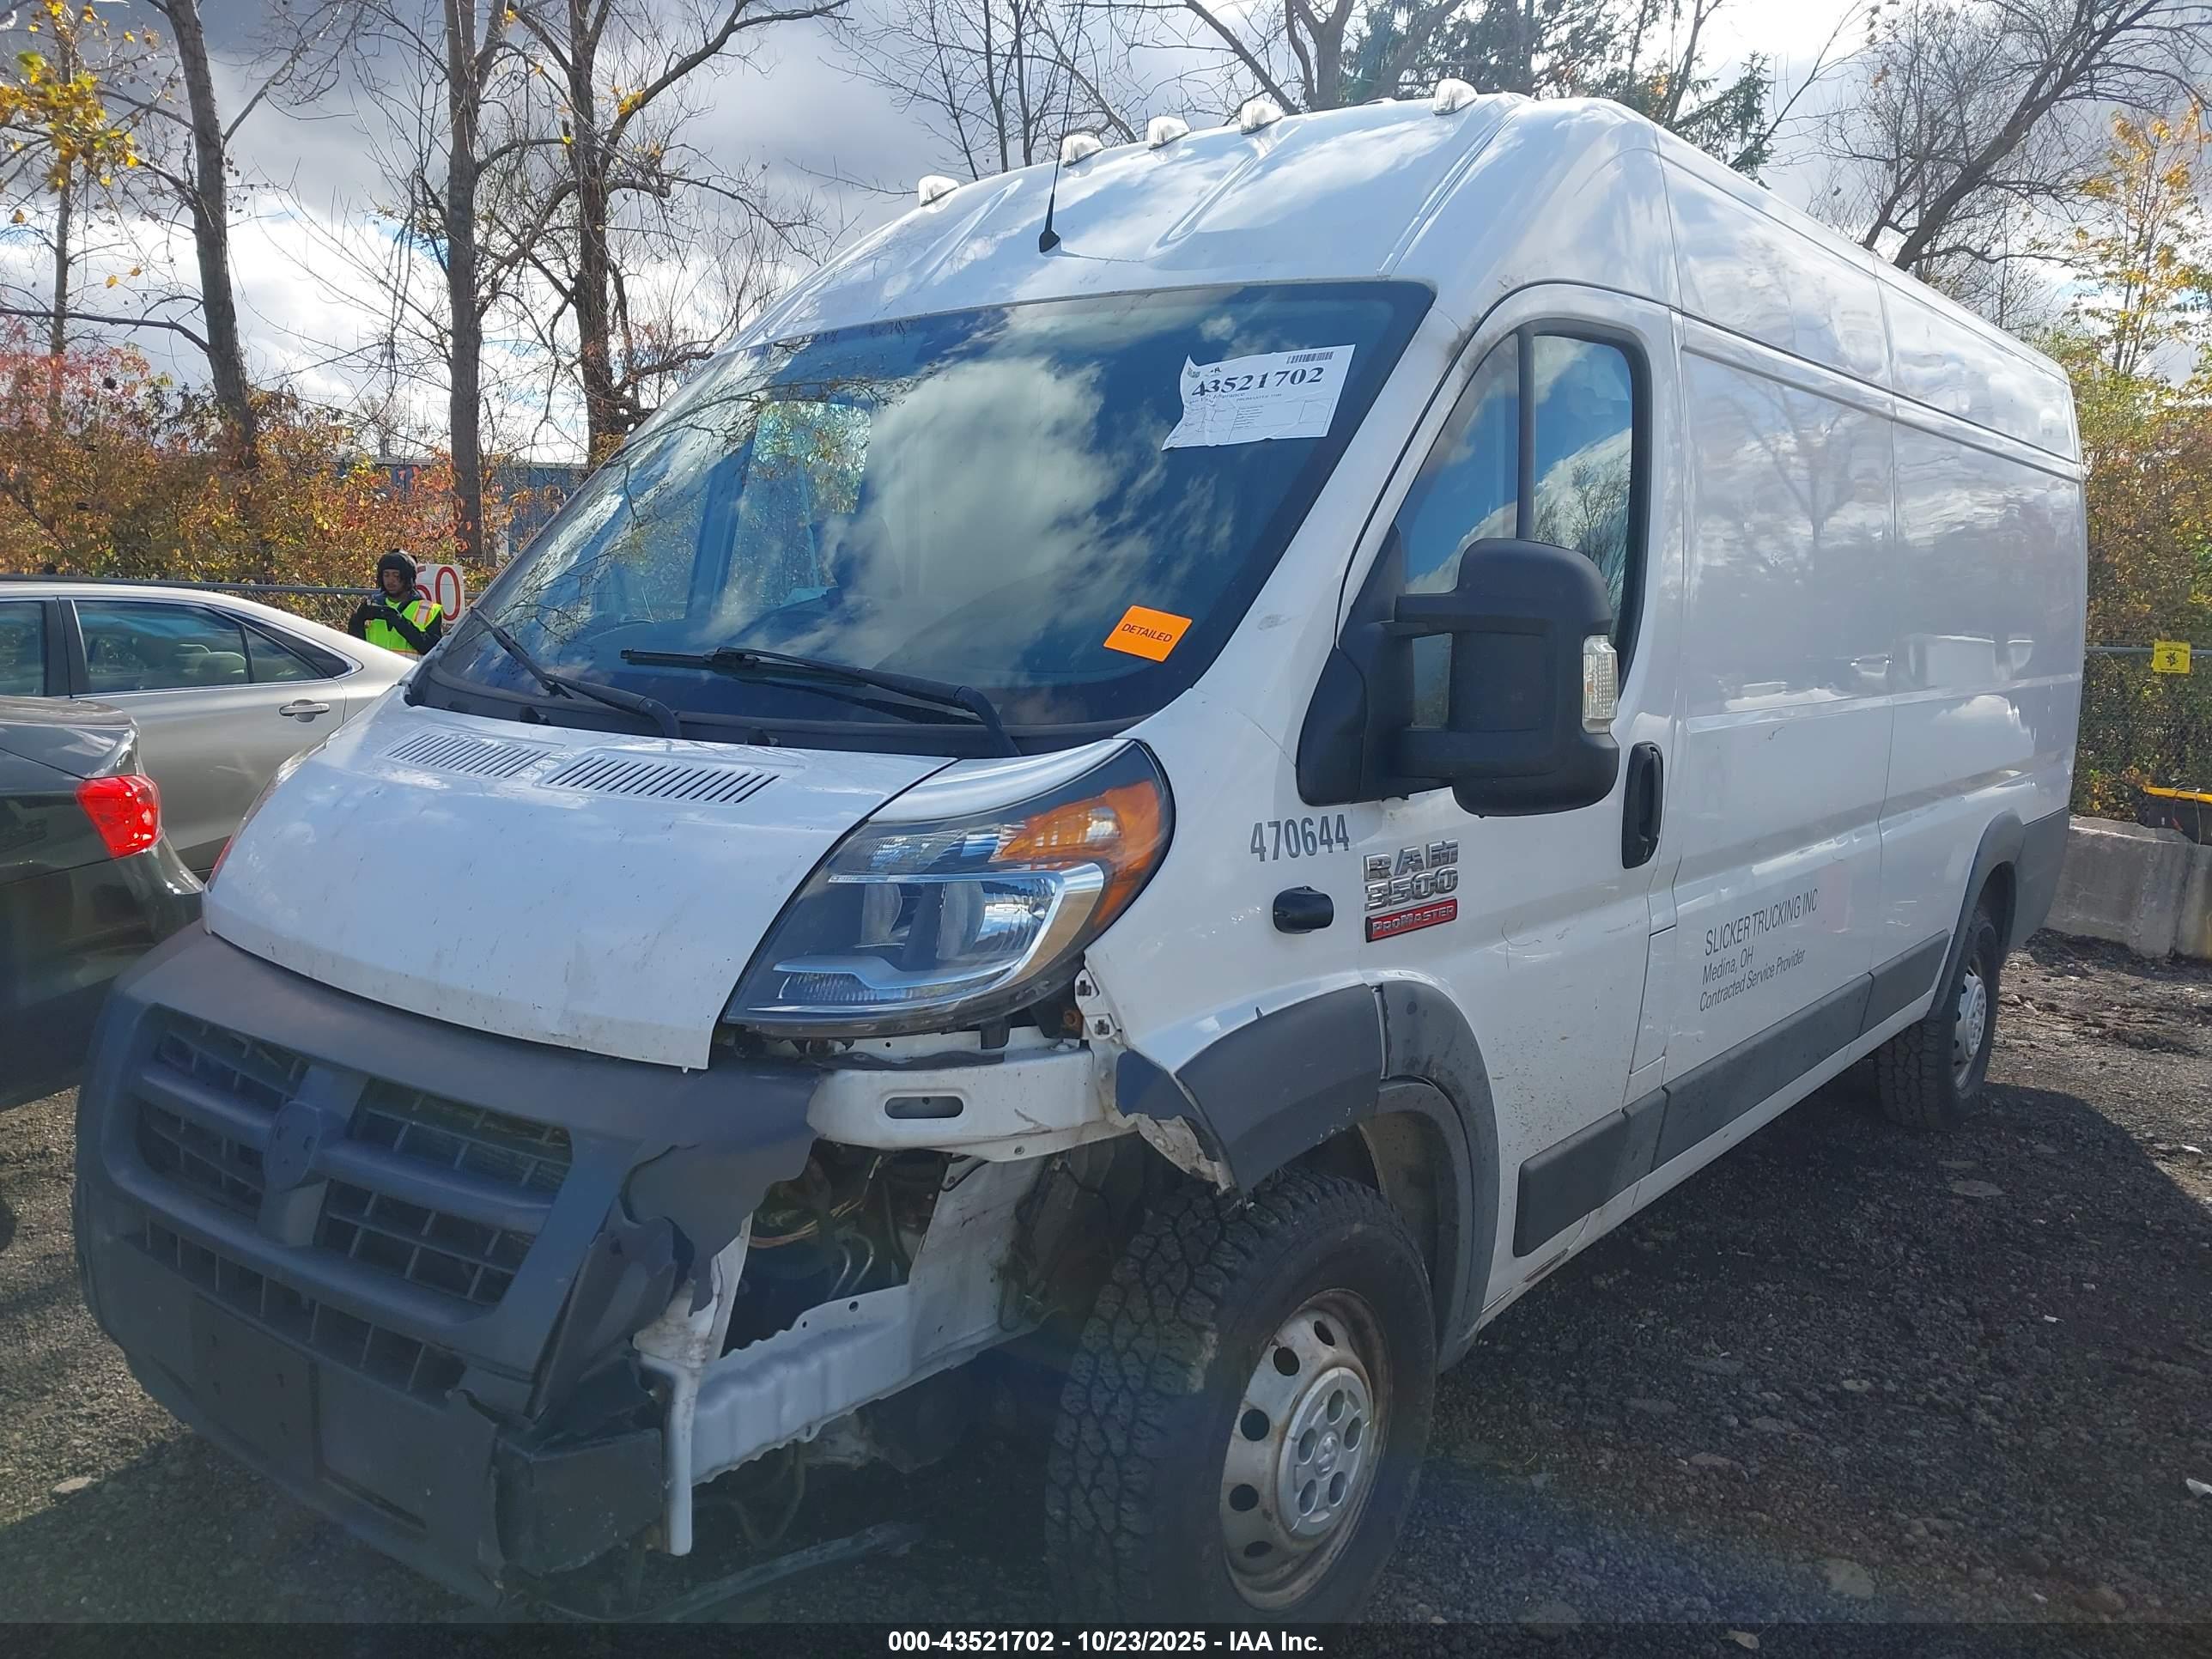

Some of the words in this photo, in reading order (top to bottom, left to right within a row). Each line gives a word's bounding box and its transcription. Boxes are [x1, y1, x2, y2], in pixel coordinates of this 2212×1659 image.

[1192, 367, 1324, 397] 43521702
[1121, 623, 1172, 642] DETAILED
[1250, 814, 1349, 862] 470644
[1363, 839, 1459, 881] RAM
[1364, 866, 1459, 911] 3500
[1705, 915, 1750, 956] SLICKER
[1753, 895, 1801, 937] TRUCKING
[1802, 888, 1818, 916] INC
[1699, 973, 1746, 1012] Contracted
[1747, 962, 1774, 989] Service
[1776, 948, 1806, 976] Provider
[1703, 957, 1737, 985] Medina,
[1740, 945, 1753, 968] OH
